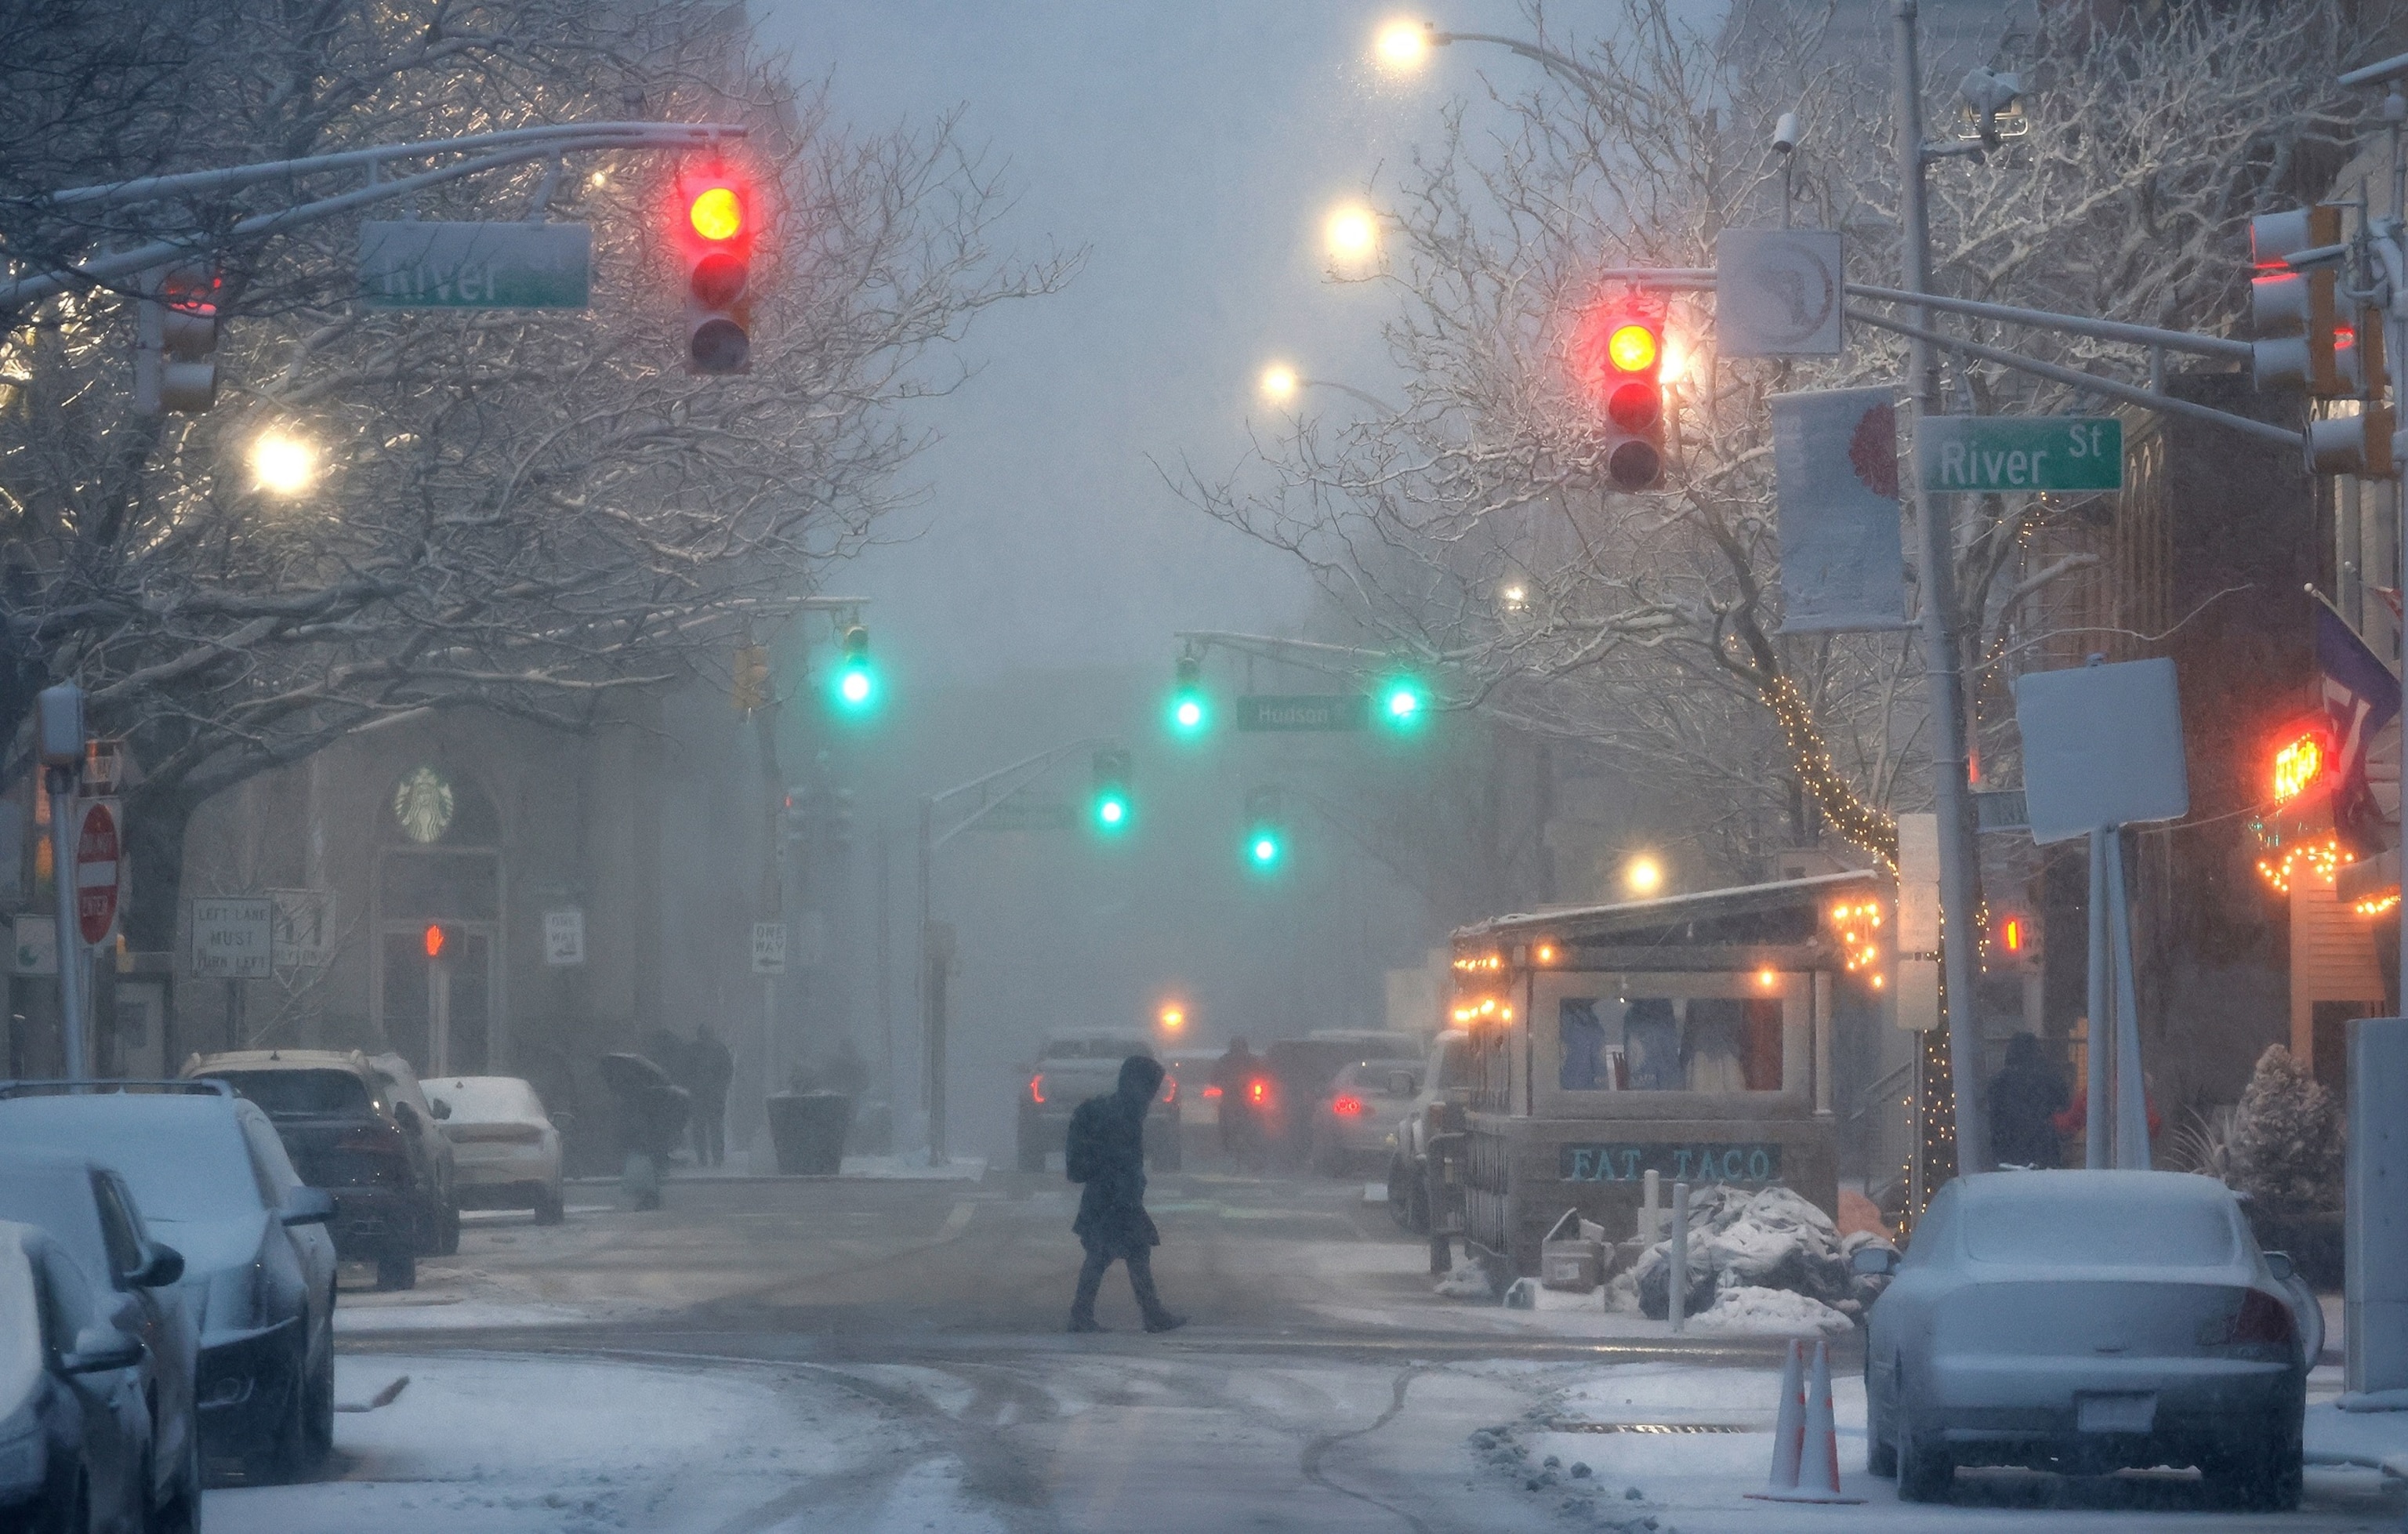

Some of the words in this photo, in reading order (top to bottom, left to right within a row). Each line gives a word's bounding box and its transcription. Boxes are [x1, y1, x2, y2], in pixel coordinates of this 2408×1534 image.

[1940, 440, 2047, 485] River
[2068, 423, 2103, 458] St
[1257, 703, 1329, 723] Hudson
[198, 908, 228, 921] LEFT
[236, 908, 267, 921] LANE
[210, 930, 255, 946] MUST
[756, 925, 783, 939] ONE
[756, 941, 784, 953] WAY
[236, 956, 265, 968] LEFT
[1572, 1148, 1641, 1181] FAT
[1674, 1148, 1769, 1182] TACO
